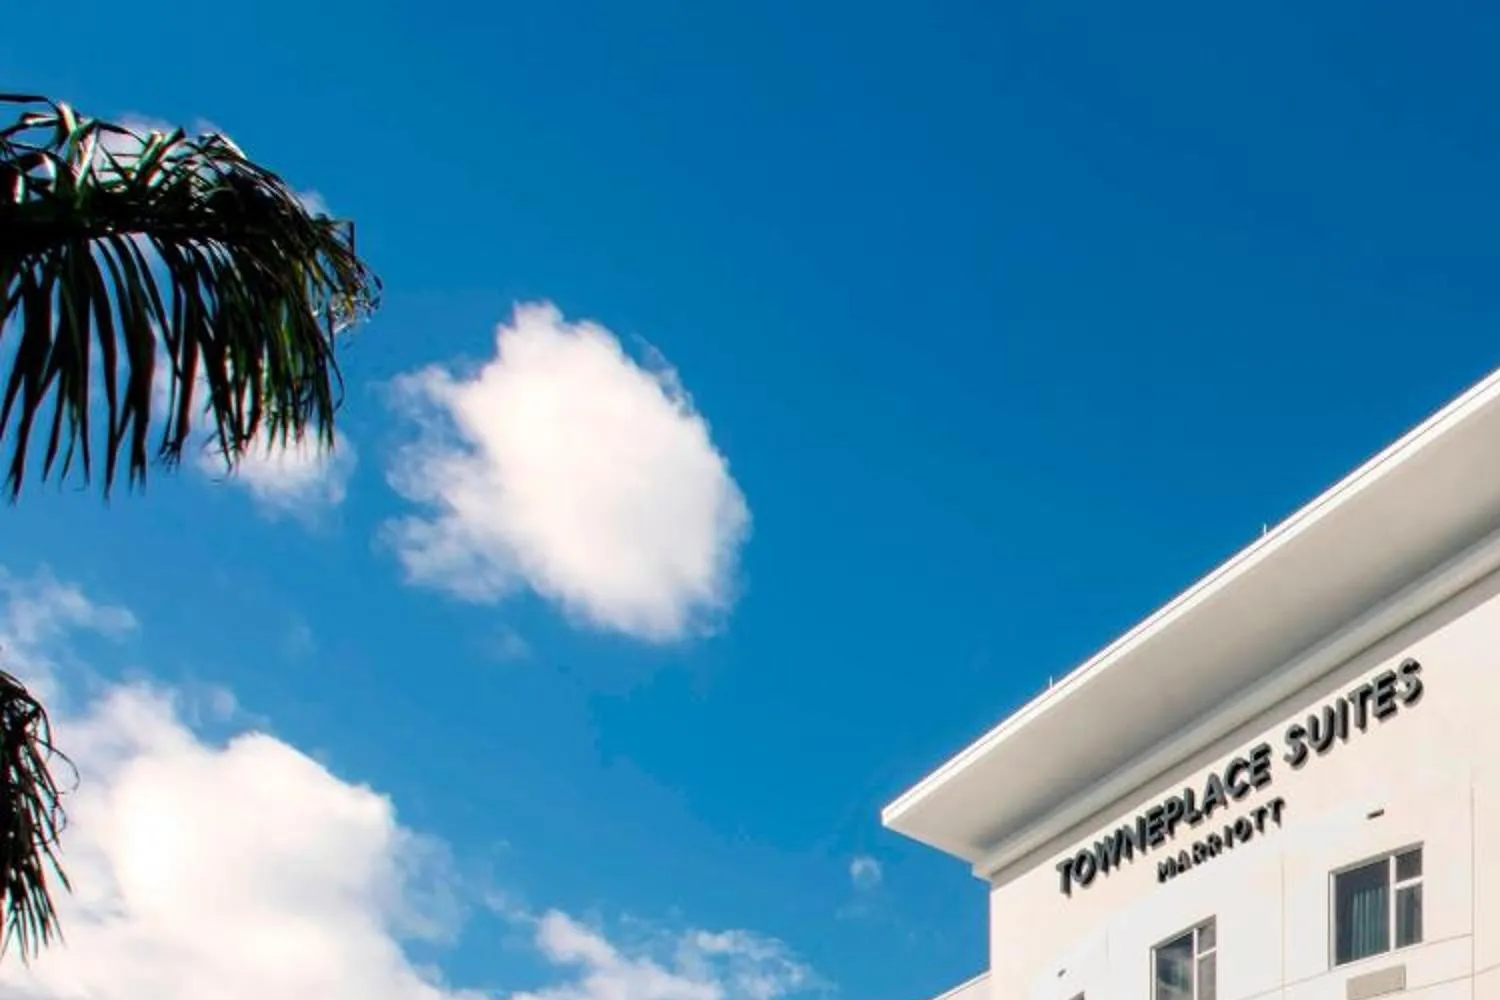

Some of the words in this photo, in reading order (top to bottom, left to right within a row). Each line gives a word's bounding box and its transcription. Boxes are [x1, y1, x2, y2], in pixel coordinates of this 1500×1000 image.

[1055, 741, 1273, 898] TOWNEPLACE
[1283, 656, 1424, 770] SUITES
[1156, 797, 1286, 884] MARRIOTT
